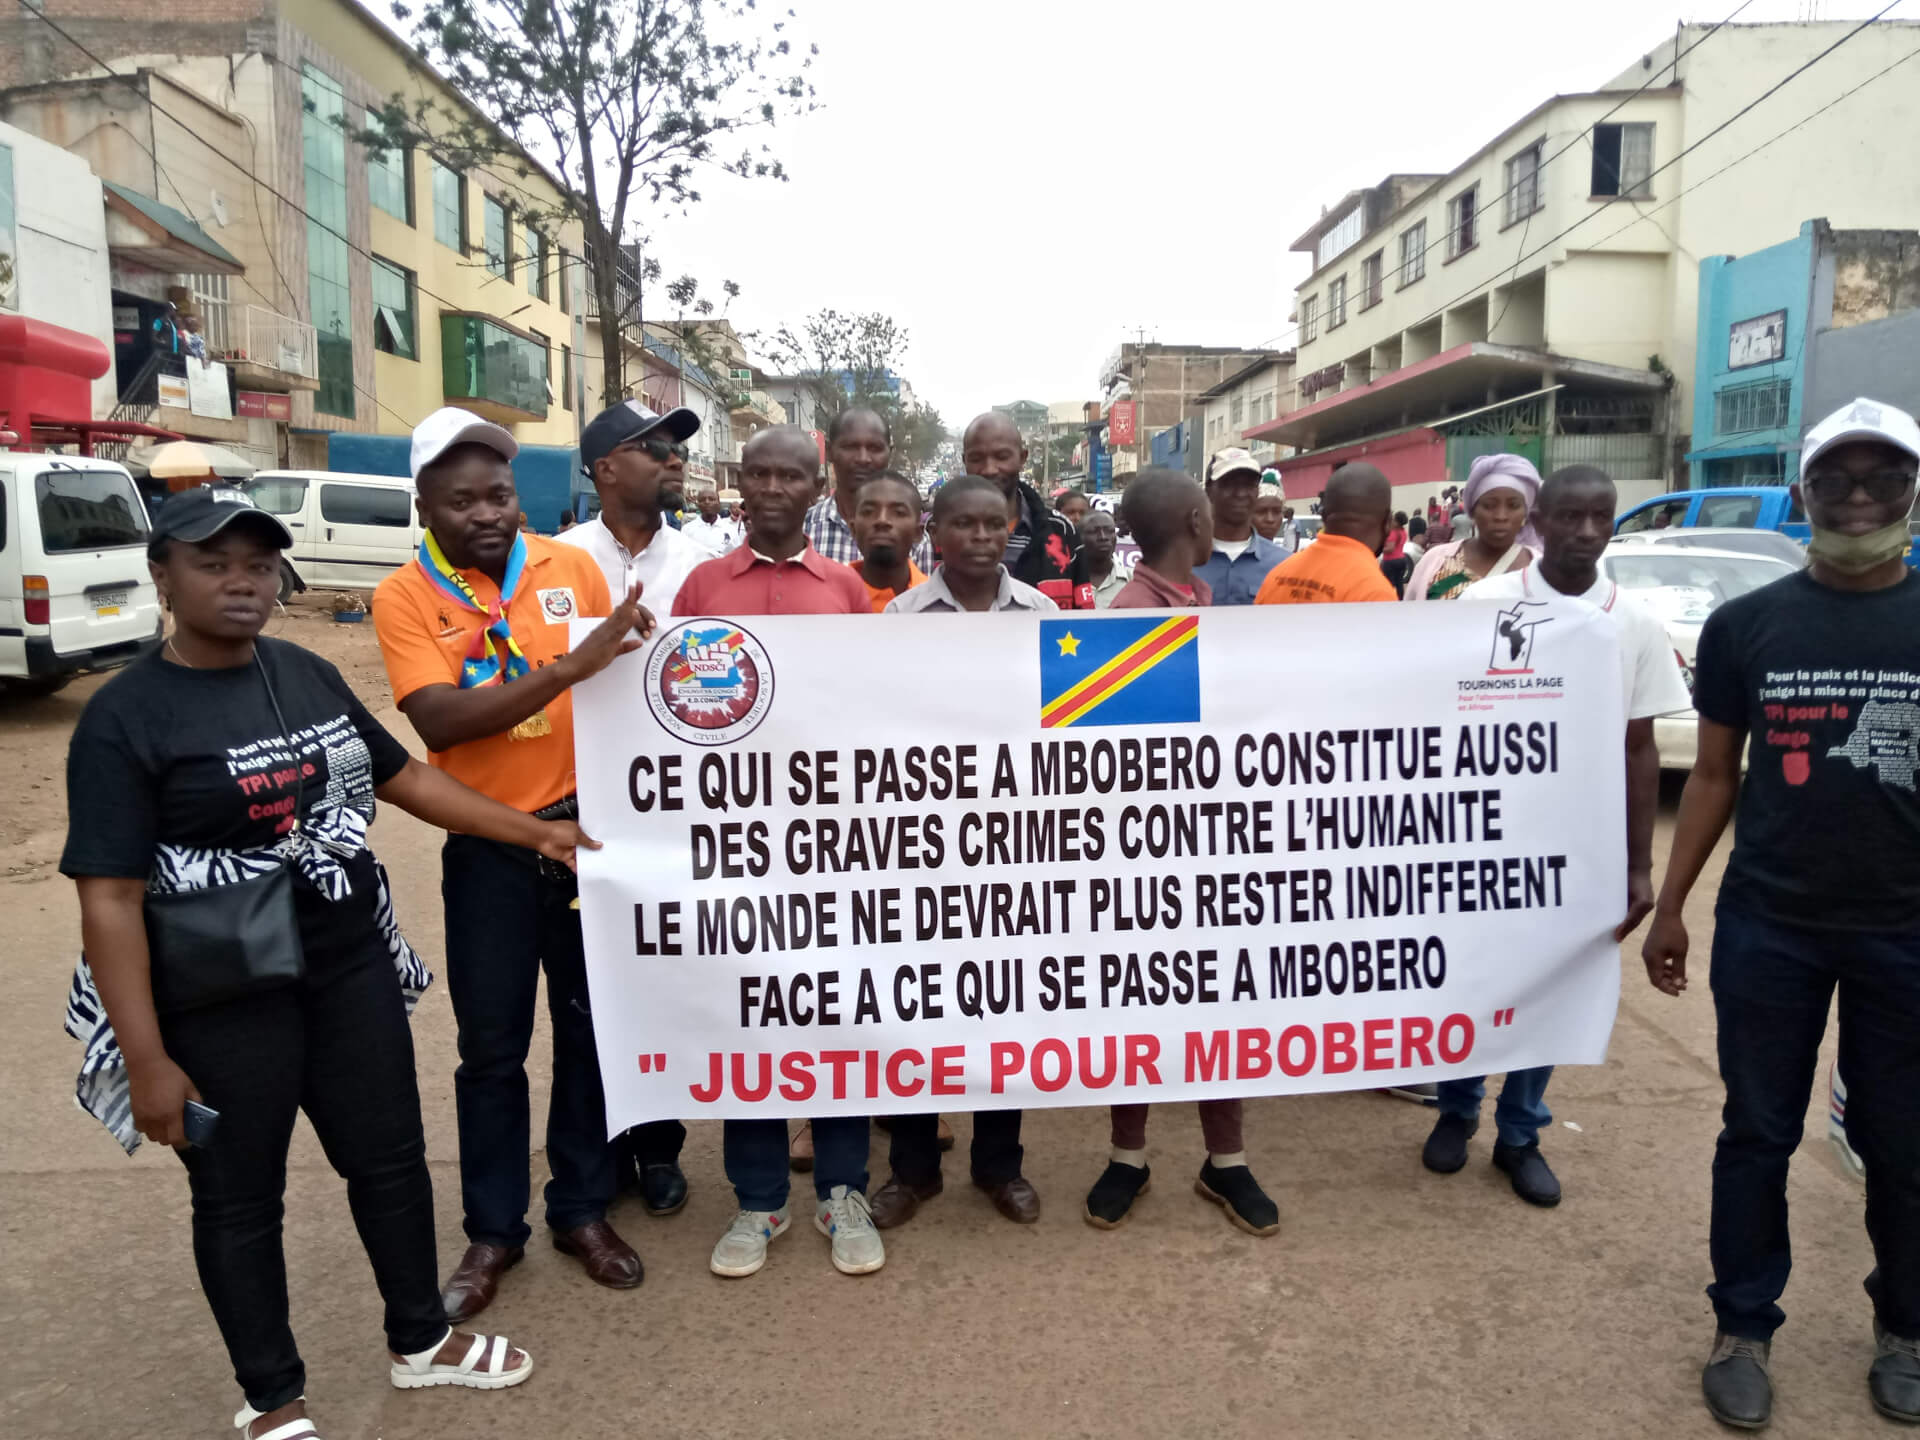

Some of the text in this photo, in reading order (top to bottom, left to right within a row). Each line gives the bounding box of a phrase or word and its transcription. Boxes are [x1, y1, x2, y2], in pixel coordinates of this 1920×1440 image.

[1457, 676, 1564, 691] TOURNONS LA PAGE
[1766, 671, 1795, 683] Pour
[1797, 669, 1810, 681] la
[1812, 668, 1842, 682] paix
[1844, 669, 1859, 681] et
[1862, 669, 1876, 681] la
[1798, 685, 1812, 697] la
[1813, 684, 1847, 697] mise
[1848, 687, 1867, 697] en
[1868, 686, 1908, 700] place
[1787, 706, 1828, 723] pour
[227, 743, 261, 758] Pour
[628, 721, 1558, 814] CE QUI SE PASSE A MBOBERO CONSTITUE AUSSI
[237, 772, 273, 795] TPI
[690, 789, 1503, 881] DES GRAVES CRIMES CONTRE L'HUMANITE
[634, 855, 1567, 956] LE MONDE NE DEVRAIT PLUS RESTER INDIFFERENT
[740, 935, 1447, 1028] FACE A CE QUI SE PASSE A MBOBERO
[688, 1044, 967, 1103] JUSTICE
[989, 1033, 1164, 1095] POUR
[1183, 1012, 1476, 1084] MBOBERO
